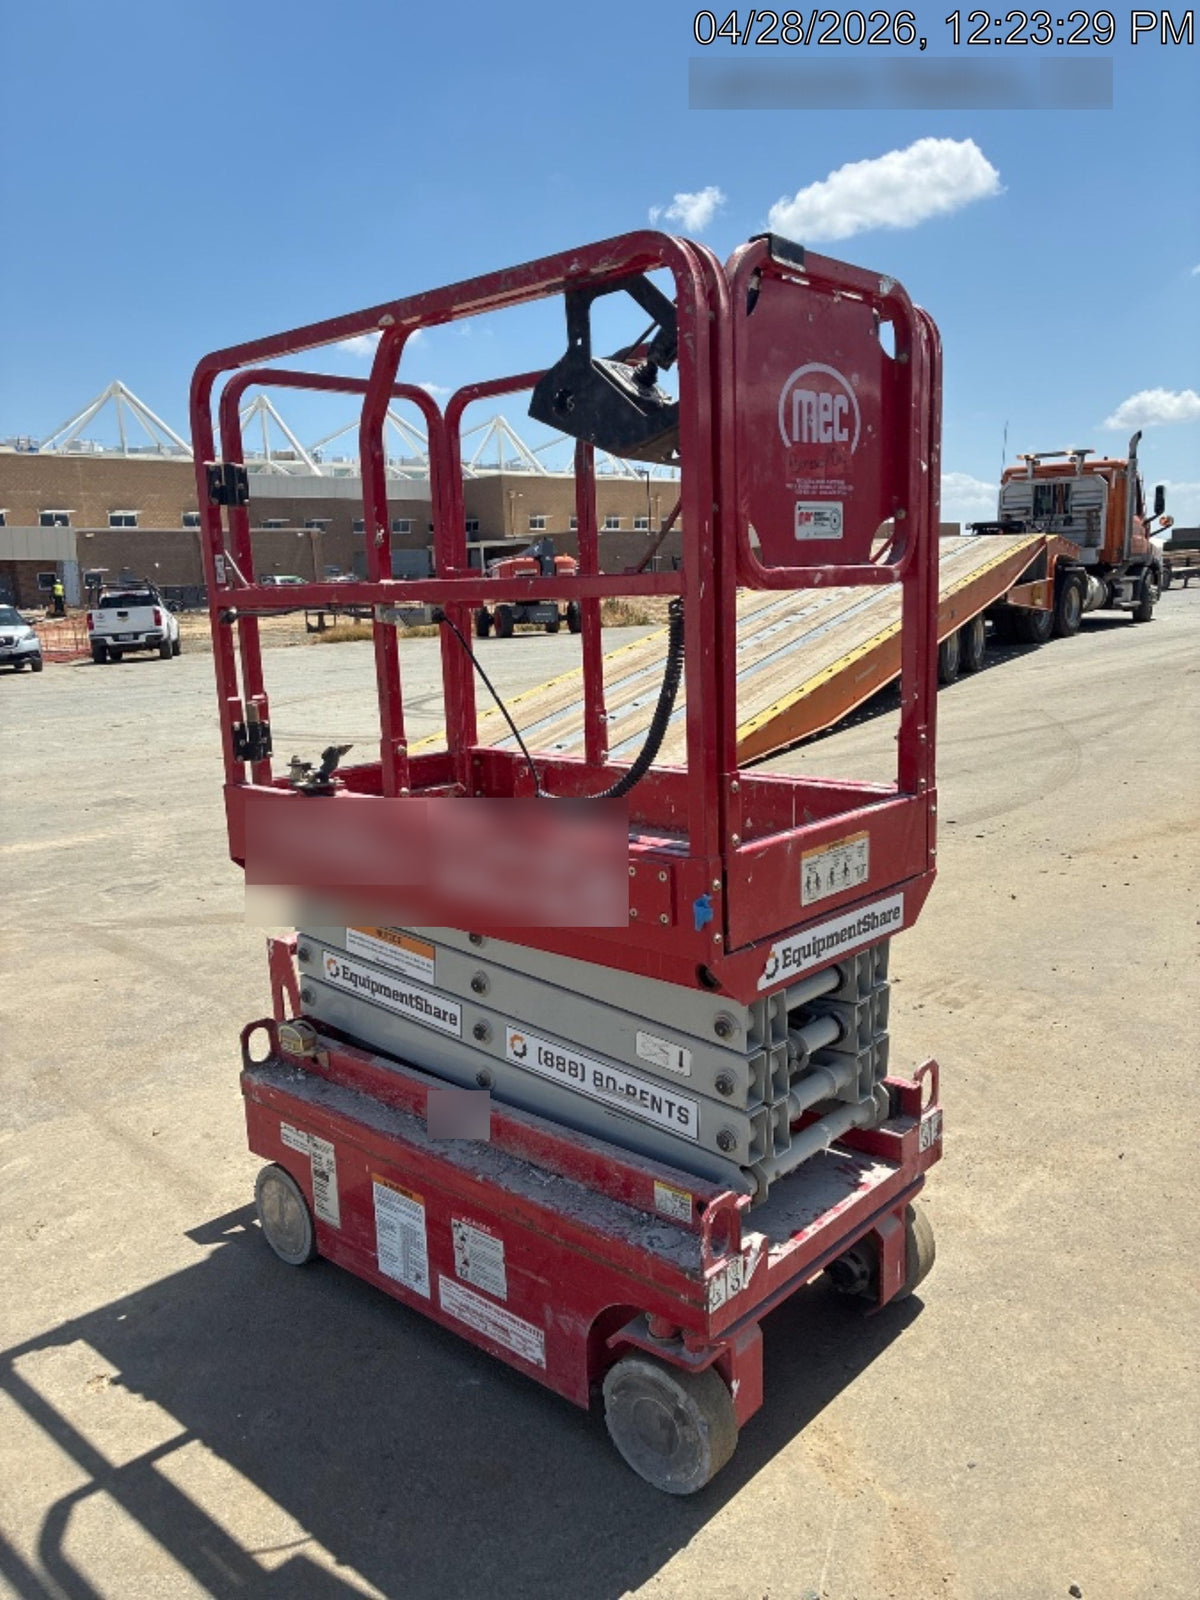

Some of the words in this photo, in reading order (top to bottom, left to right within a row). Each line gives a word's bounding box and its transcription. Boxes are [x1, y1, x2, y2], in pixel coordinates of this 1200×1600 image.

[782, 905, 901, 970] EquipmentShare
[342, 965, 458, 1027] EquipmentShare
[537, 1046, 586, 1083] (888)
